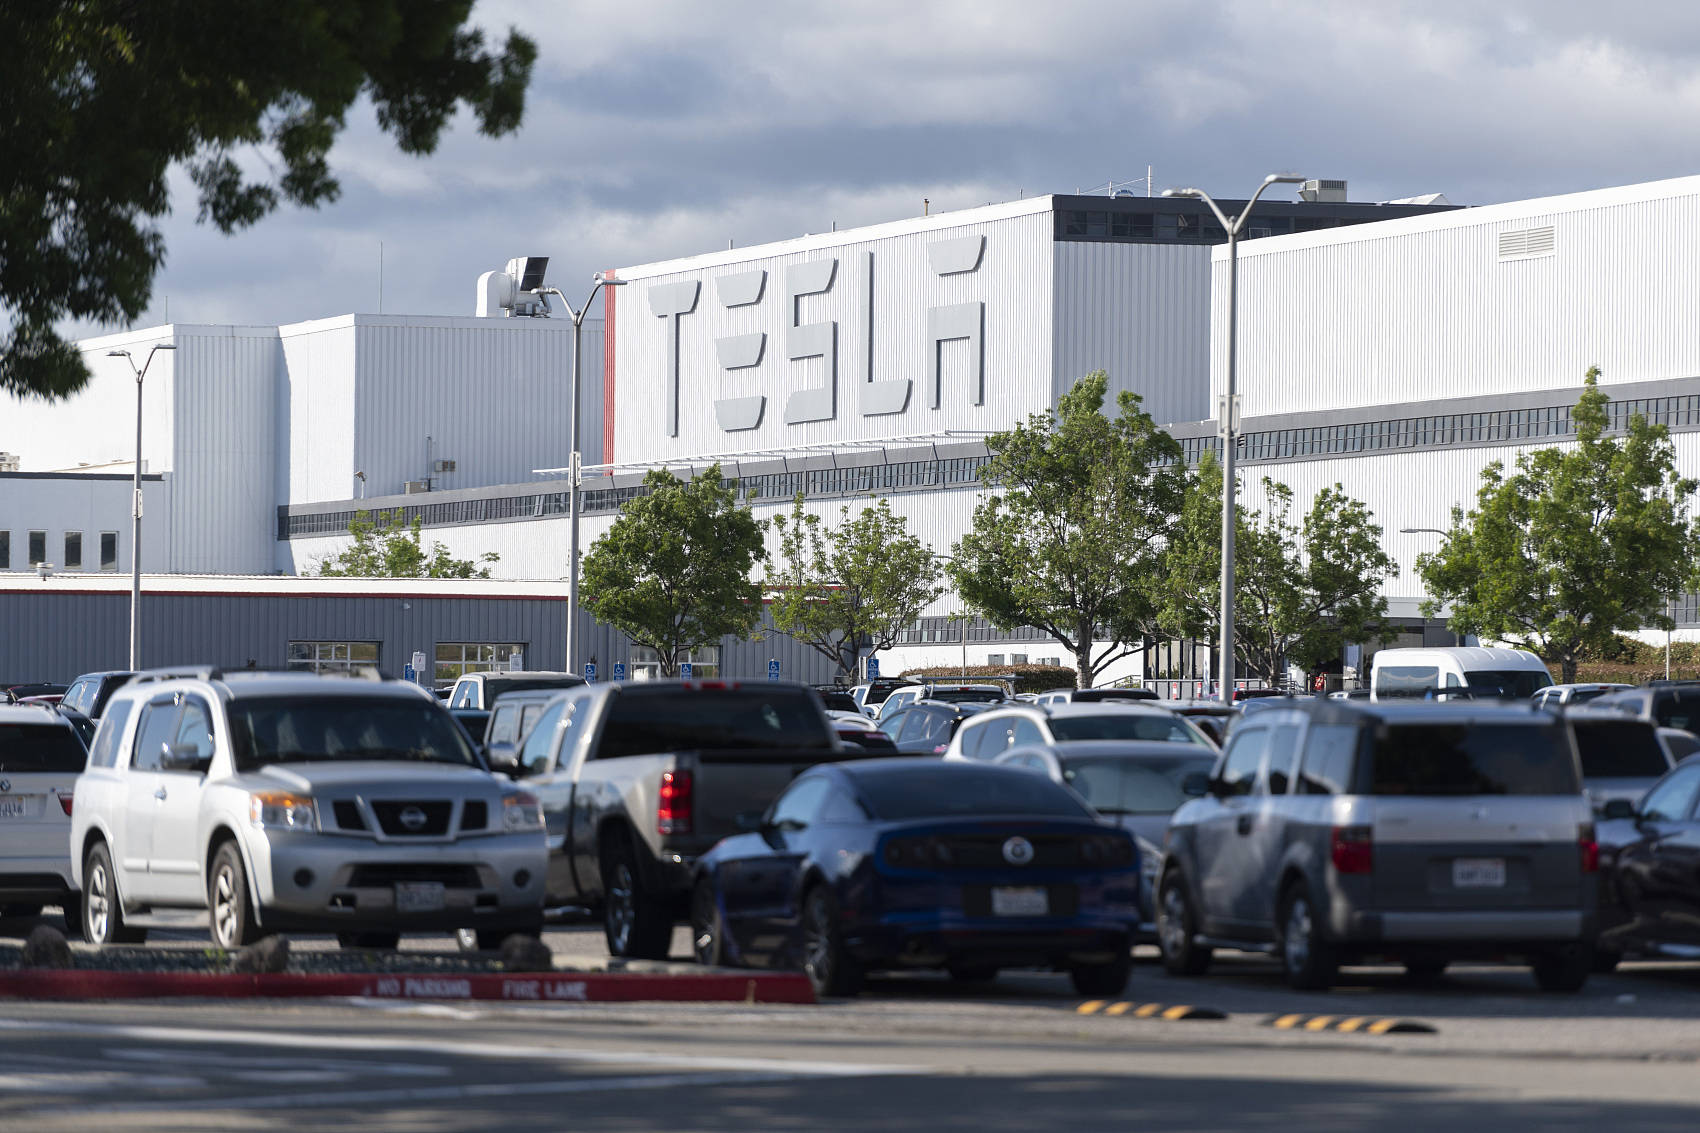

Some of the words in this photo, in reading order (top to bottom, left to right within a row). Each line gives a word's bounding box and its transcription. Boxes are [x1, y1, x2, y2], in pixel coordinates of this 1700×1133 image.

[649, 235, 986, 438] TESLA
[378, 978, 399, 996] NO
[404, 978, 471, 997] PARKING
[503, 979, 539, 999] FIRE
[544, 981, 587, 1000] LANE
